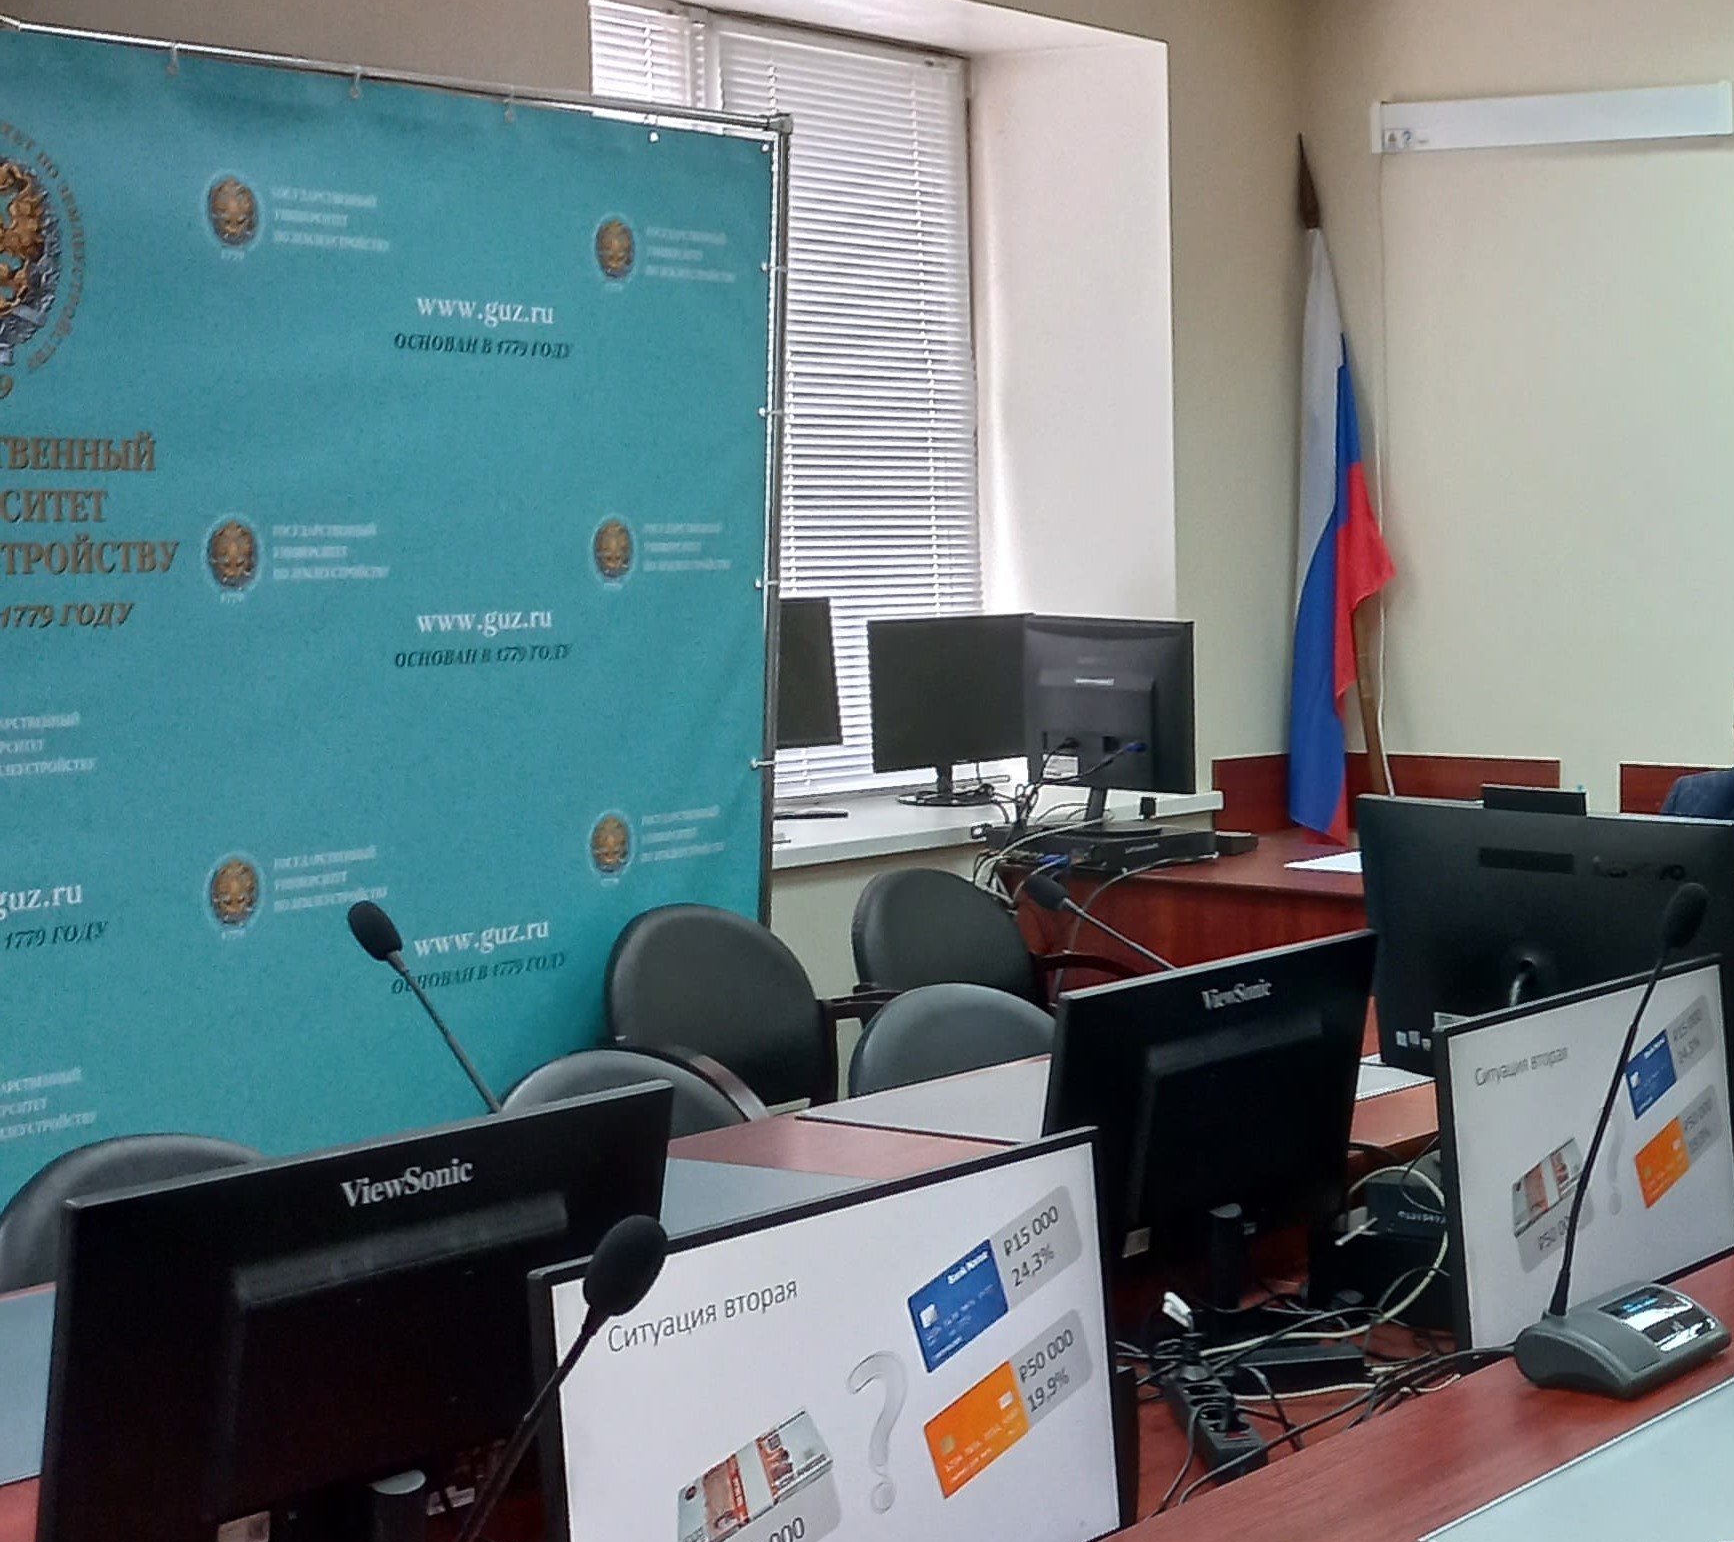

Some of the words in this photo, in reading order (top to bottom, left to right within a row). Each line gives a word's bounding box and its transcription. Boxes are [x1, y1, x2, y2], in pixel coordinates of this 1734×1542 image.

[416, 297, 555, 329] www.guz.ru
[394, 332, 479, 355] ОСНОВАН
[481, 338, 494, 356] В
[0, 487, 109, 524] СИТЕТ
[58, 601, 136, 630] ГОДУ
[416, 610, 553, 639] www.guz.ru
[395, 649, 477, 669] ОСНОВАН
[5, 929, 46, 951] 1779
[52, 920, 109, 945] ГОДУ
[413, 920, 550, 956] www.guz.ru
[340, 1157, 475, 1208] ViewSonic
[1032, 1205, 1060, 1236] 000
[1011, 1243, 1056, 1289] 24,3%
[607, 1303, 717, 1353] Ситуация
[724, 1280, 799, 1320] вторая
[1047, 1328, 1075, 1360] 000
[1027, 1367, 1071, 1413] 19,9%
